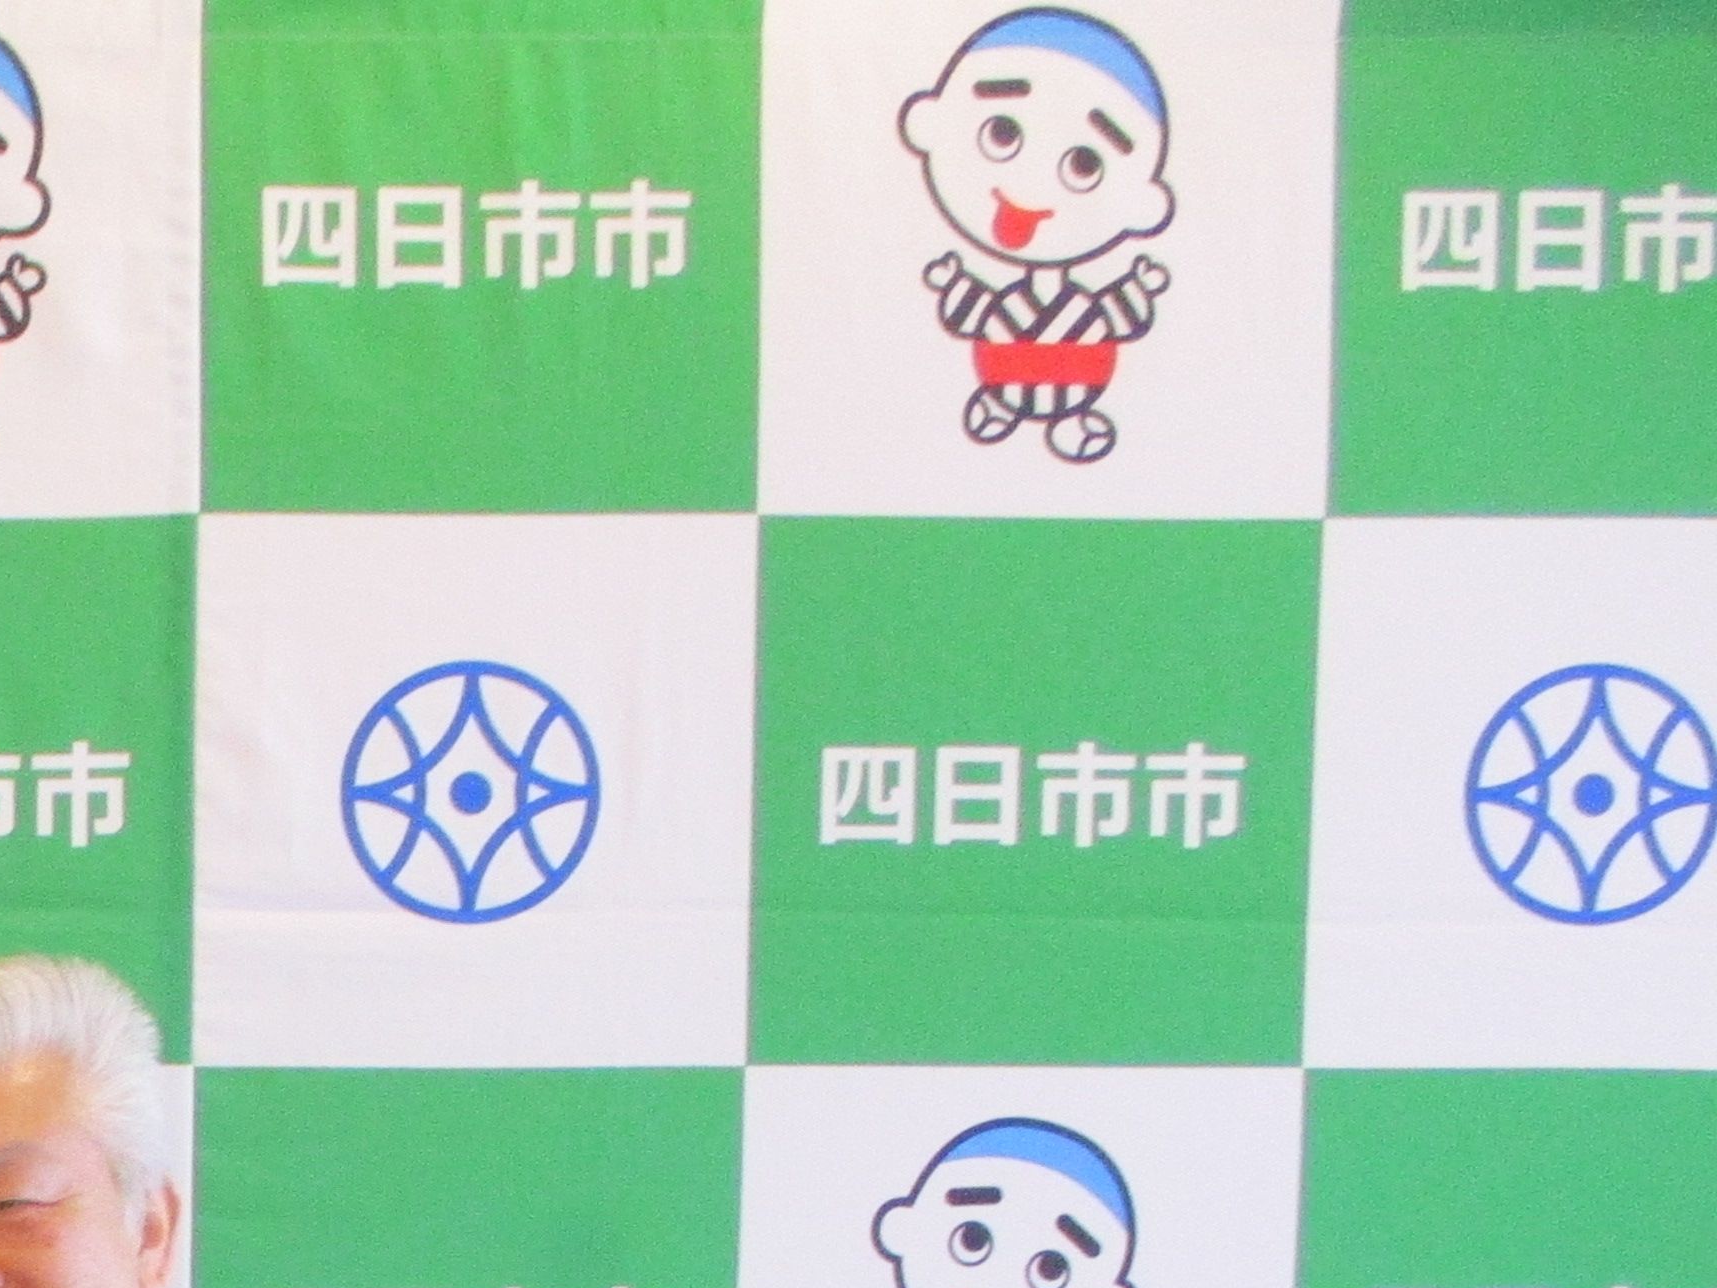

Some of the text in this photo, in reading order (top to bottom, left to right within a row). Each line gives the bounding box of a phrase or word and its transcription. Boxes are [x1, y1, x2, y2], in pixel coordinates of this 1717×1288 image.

[261, 178, 693, 289] 四日市市
[1401, 183, 1717, 293] 四日市
[820, 741, 1247, 848] 四日市市
